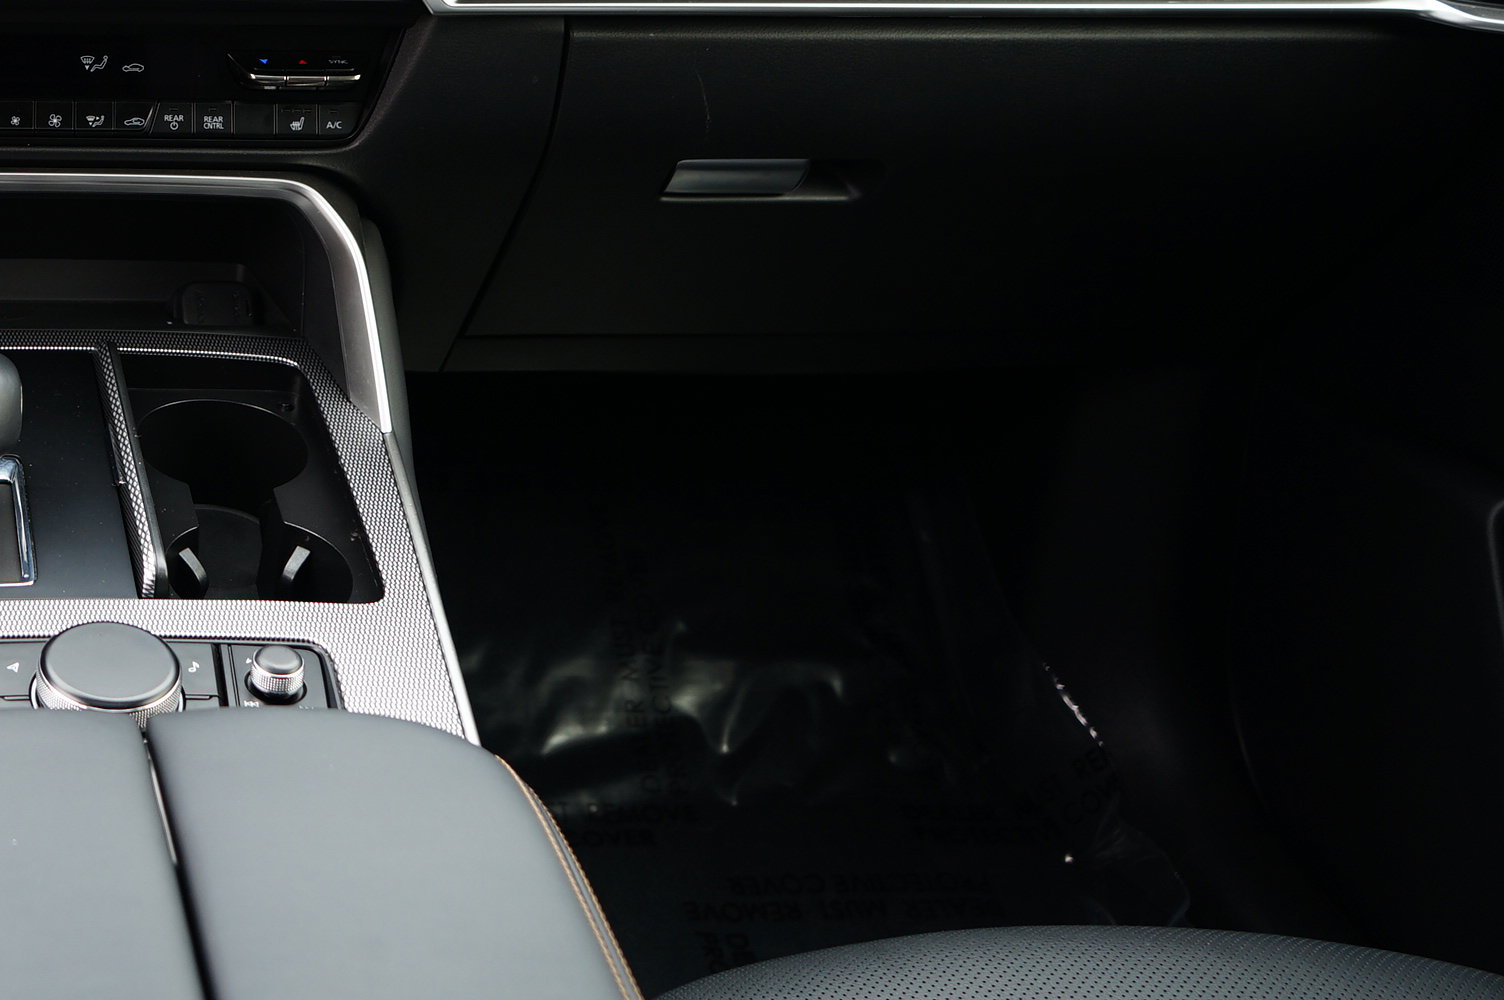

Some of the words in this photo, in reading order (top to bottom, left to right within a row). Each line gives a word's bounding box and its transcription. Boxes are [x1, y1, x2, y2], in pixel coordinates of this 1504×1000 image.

[164, 114, 184, 122] REAR
[203, 115, 223, 123] REAR
[203, 122, 224, 130] CNTRL
[326, 121, 342, 130] A/C
